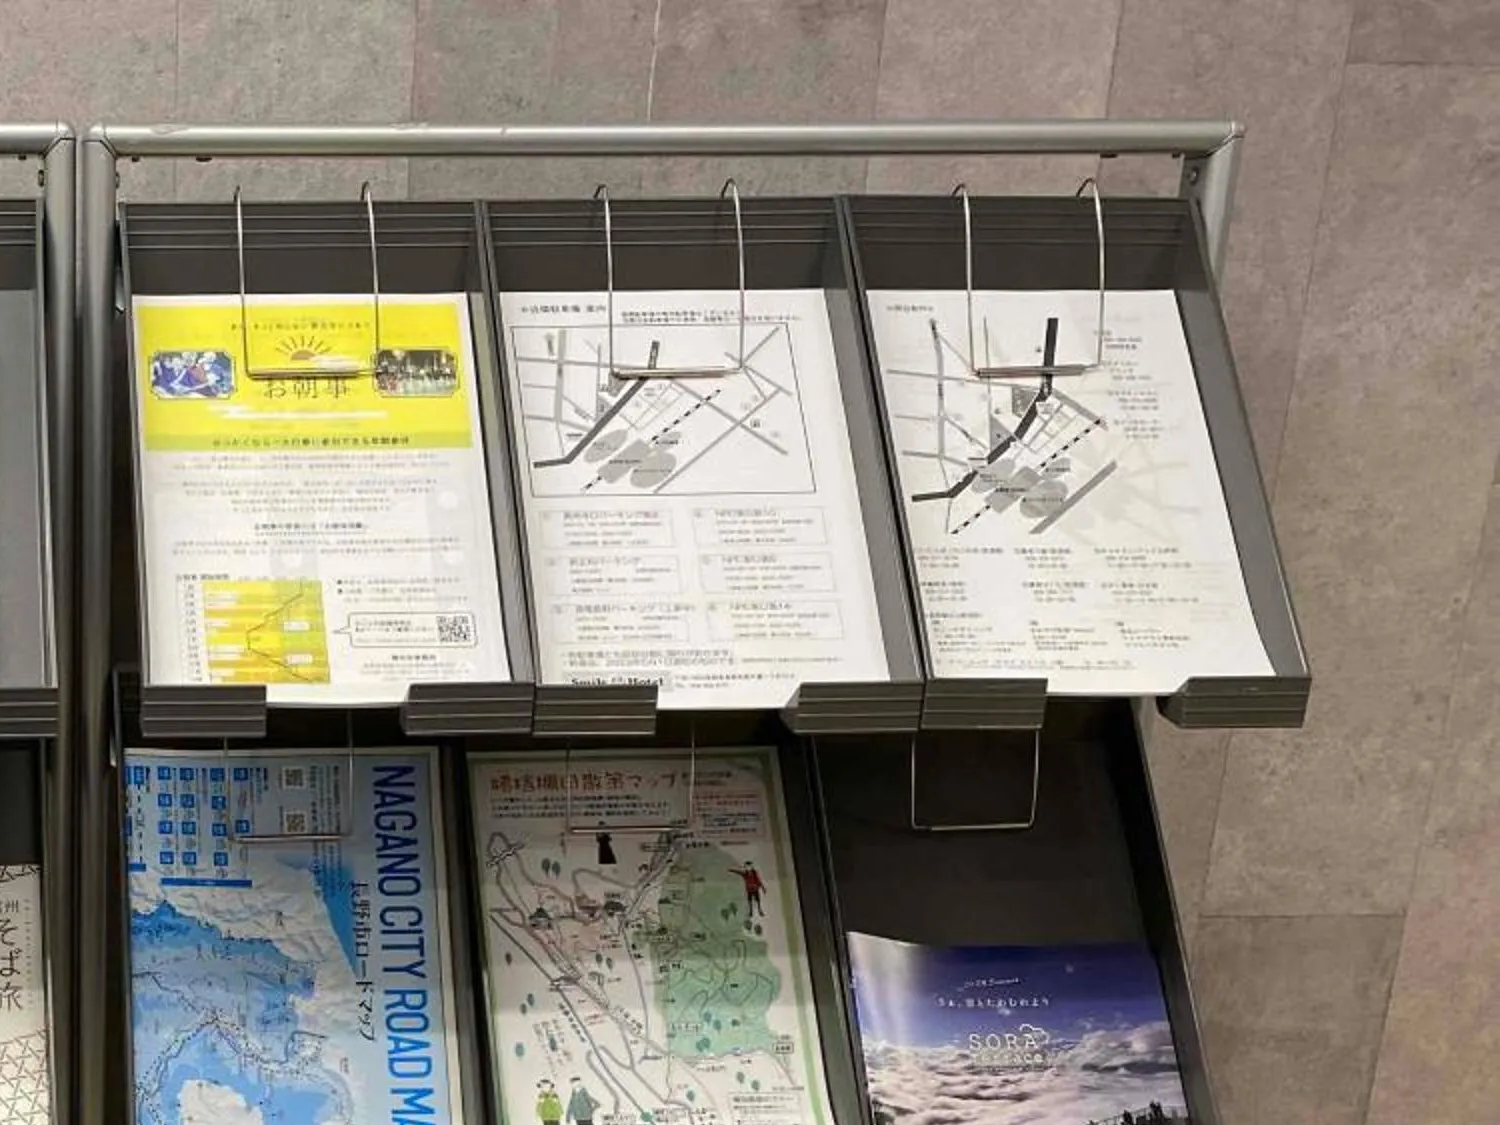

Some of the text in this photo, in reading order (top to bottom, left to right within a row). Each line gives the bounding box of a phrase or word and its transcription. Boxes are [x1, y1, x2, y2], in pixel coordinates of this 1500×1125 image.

[372, 764, 422, 897] NAGANO
[349, 880, 377, 1042] 長野市ロードマップ
[378, 904, 428, 980] CITY
[383, 989, 434, 1079] ROAD
[968, 1033, 1038, 1051] SORA
